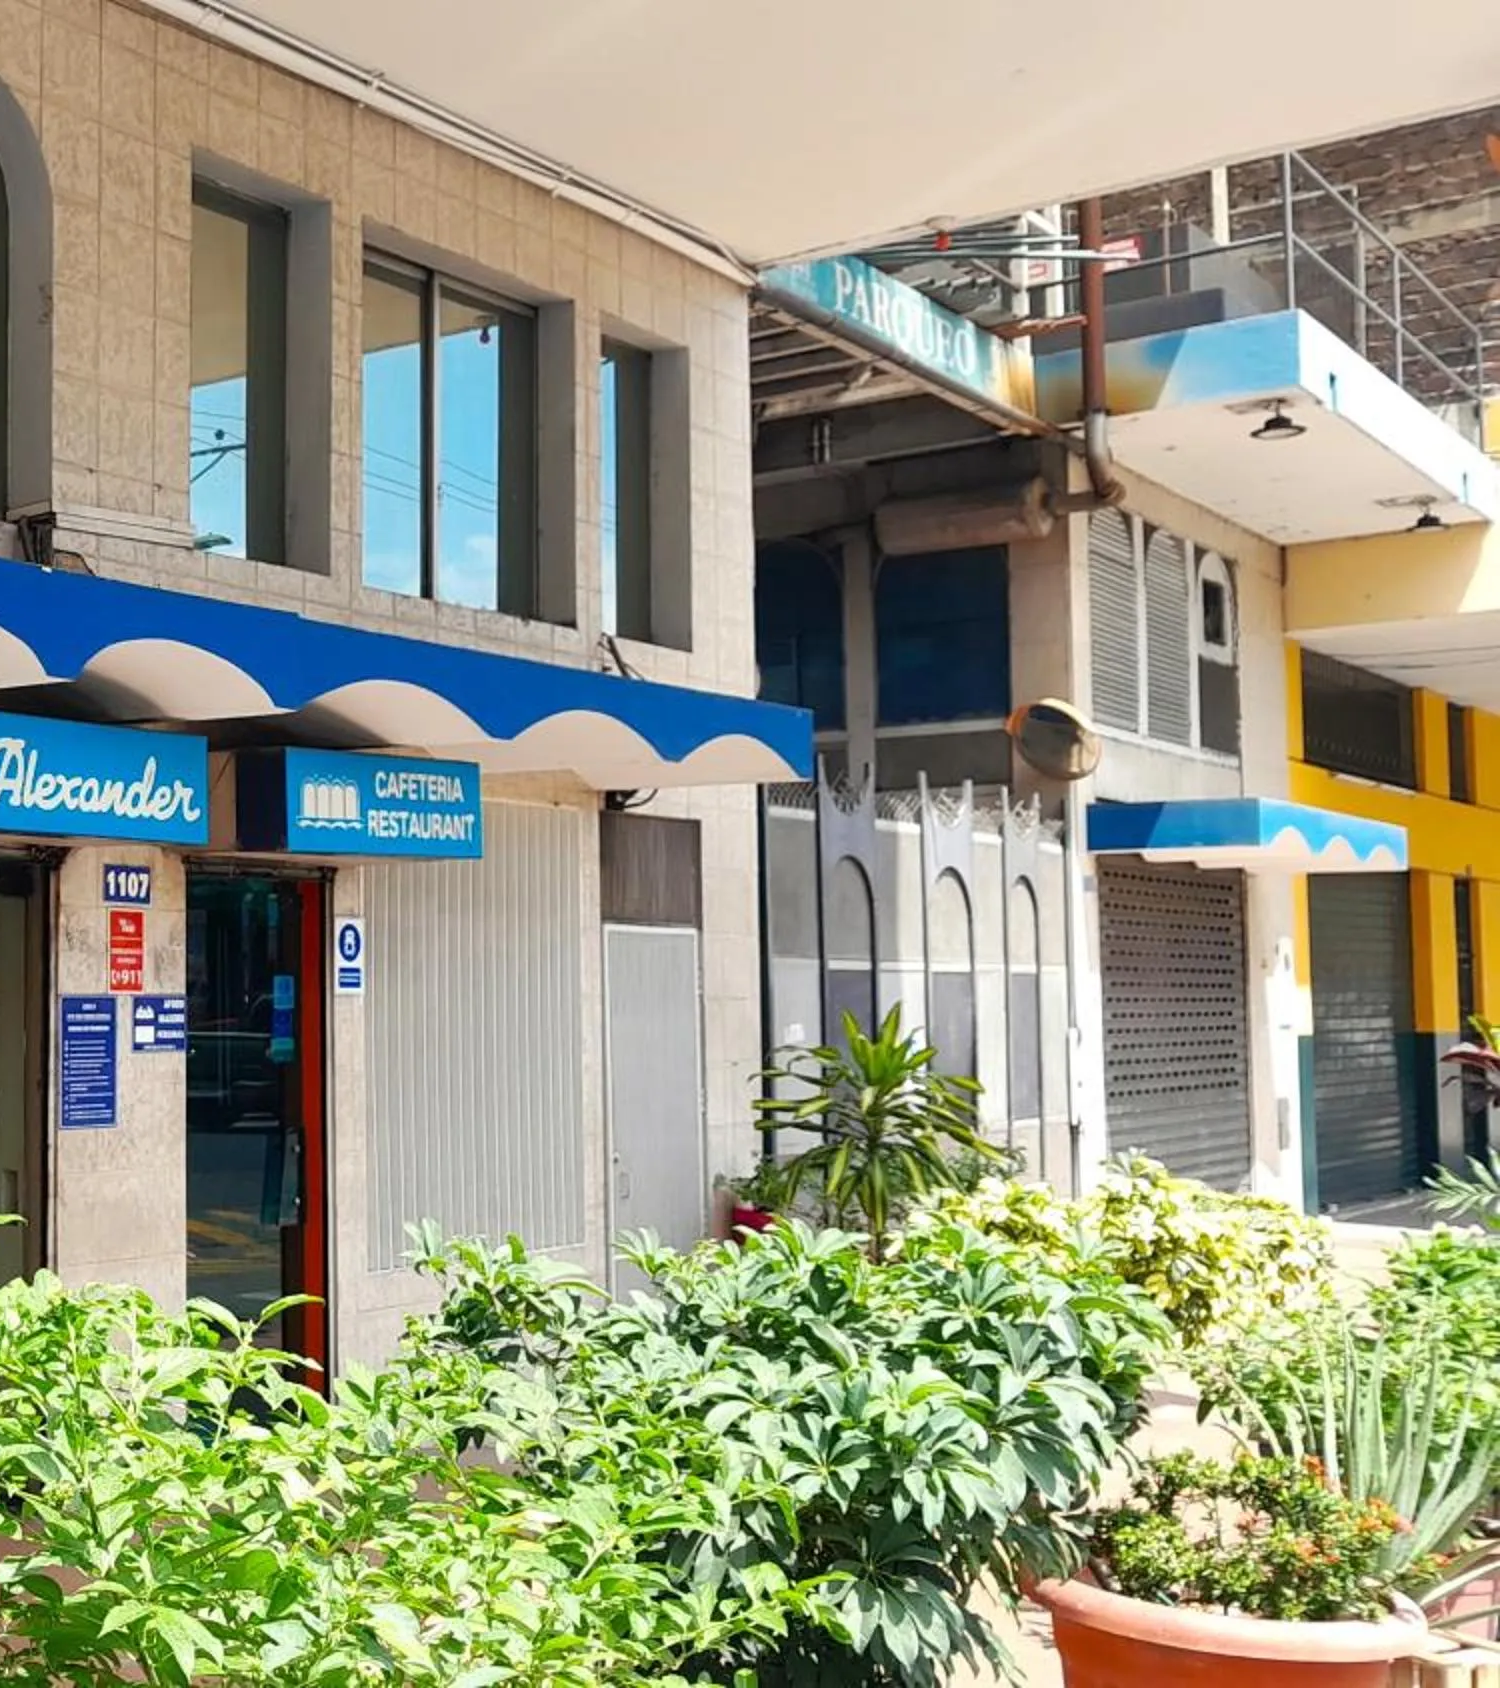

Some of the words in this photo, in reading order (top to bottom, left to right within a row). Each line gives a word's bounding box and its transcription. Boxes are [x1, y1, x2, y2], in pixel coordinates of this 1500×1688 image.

[834, 260, 978, 377] PARQUEO
[374, 769, 465, 803] CAFETERIA
[366, 808, 475, 842] RESTAURANT
[106, 870, 149, 899] 1107
